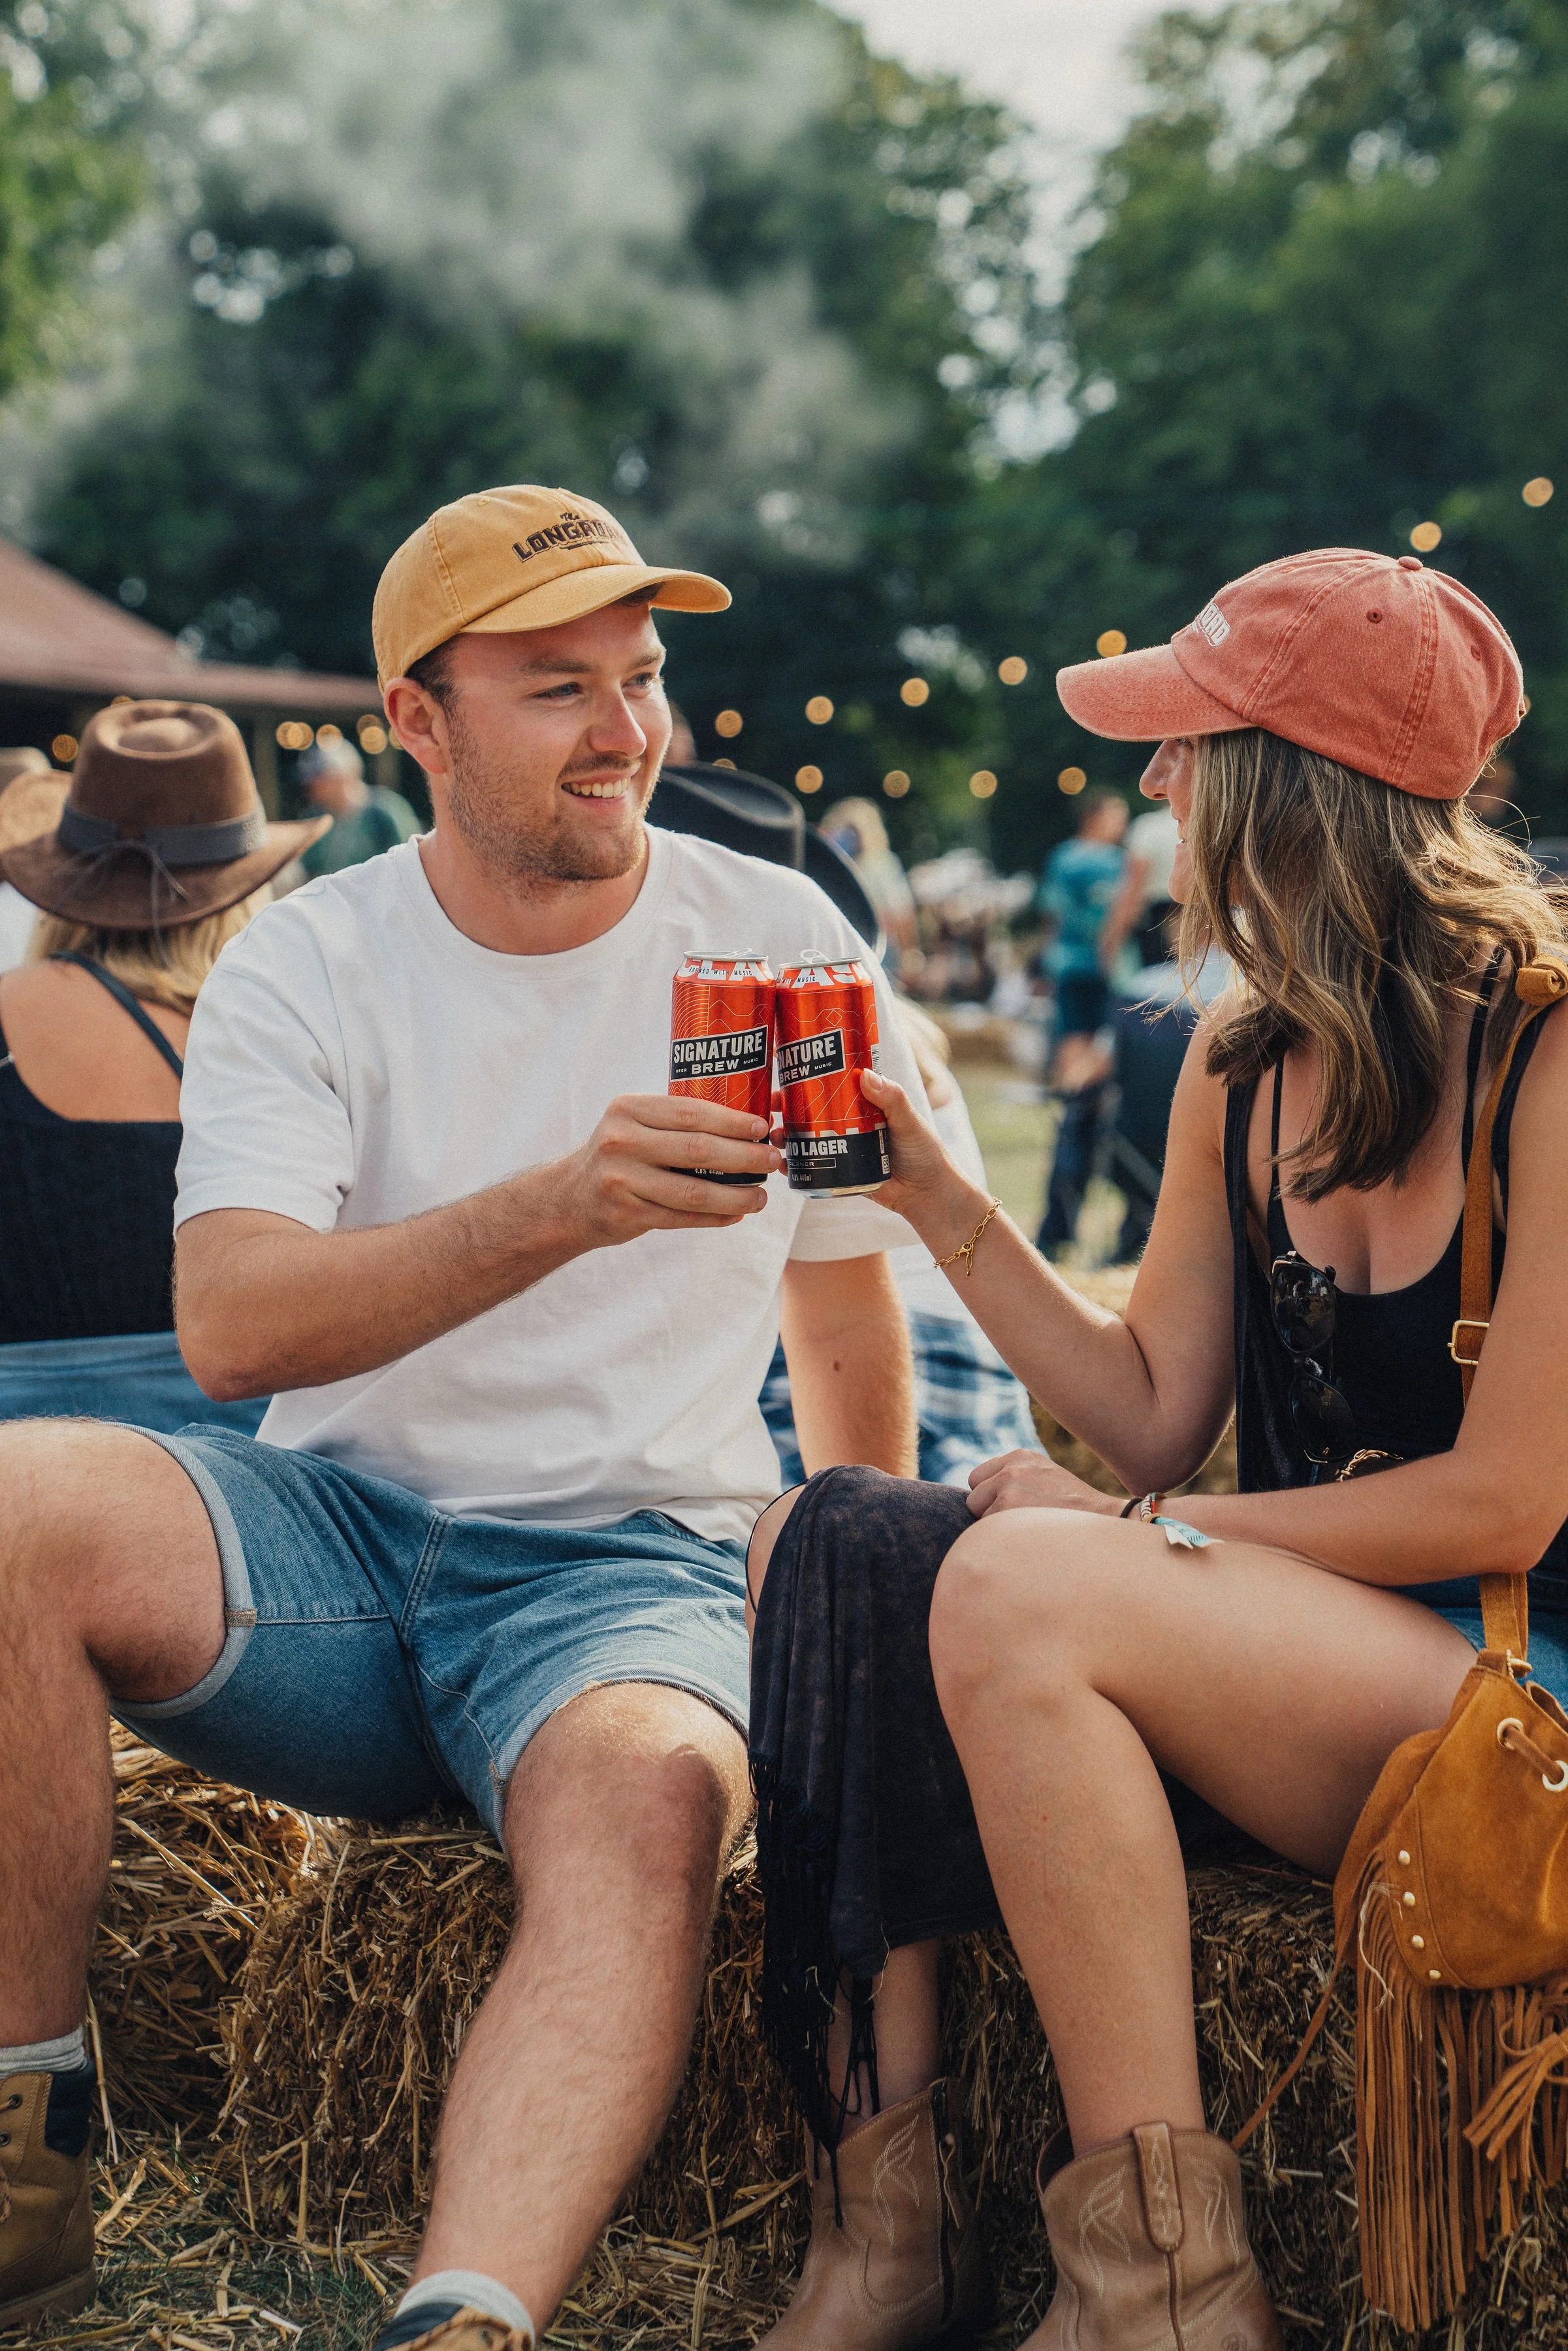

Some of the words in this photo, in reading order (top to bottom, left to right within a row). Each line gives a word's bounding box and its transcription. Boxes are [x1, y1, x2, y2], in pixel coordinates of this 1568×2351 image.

[673, 1031, 763, 1064] SIGNATURE
[777, 1035, 837, 1070] NATURE
[691, 1058, 739, 1075] BREW
[743, 1057, 759, 1065] MUSIC
[779, 1064, 810, 1083] BREW
[814, 1061, 833, 1070] MUSIC
[801, 1139, 848, 1157] LAGER
